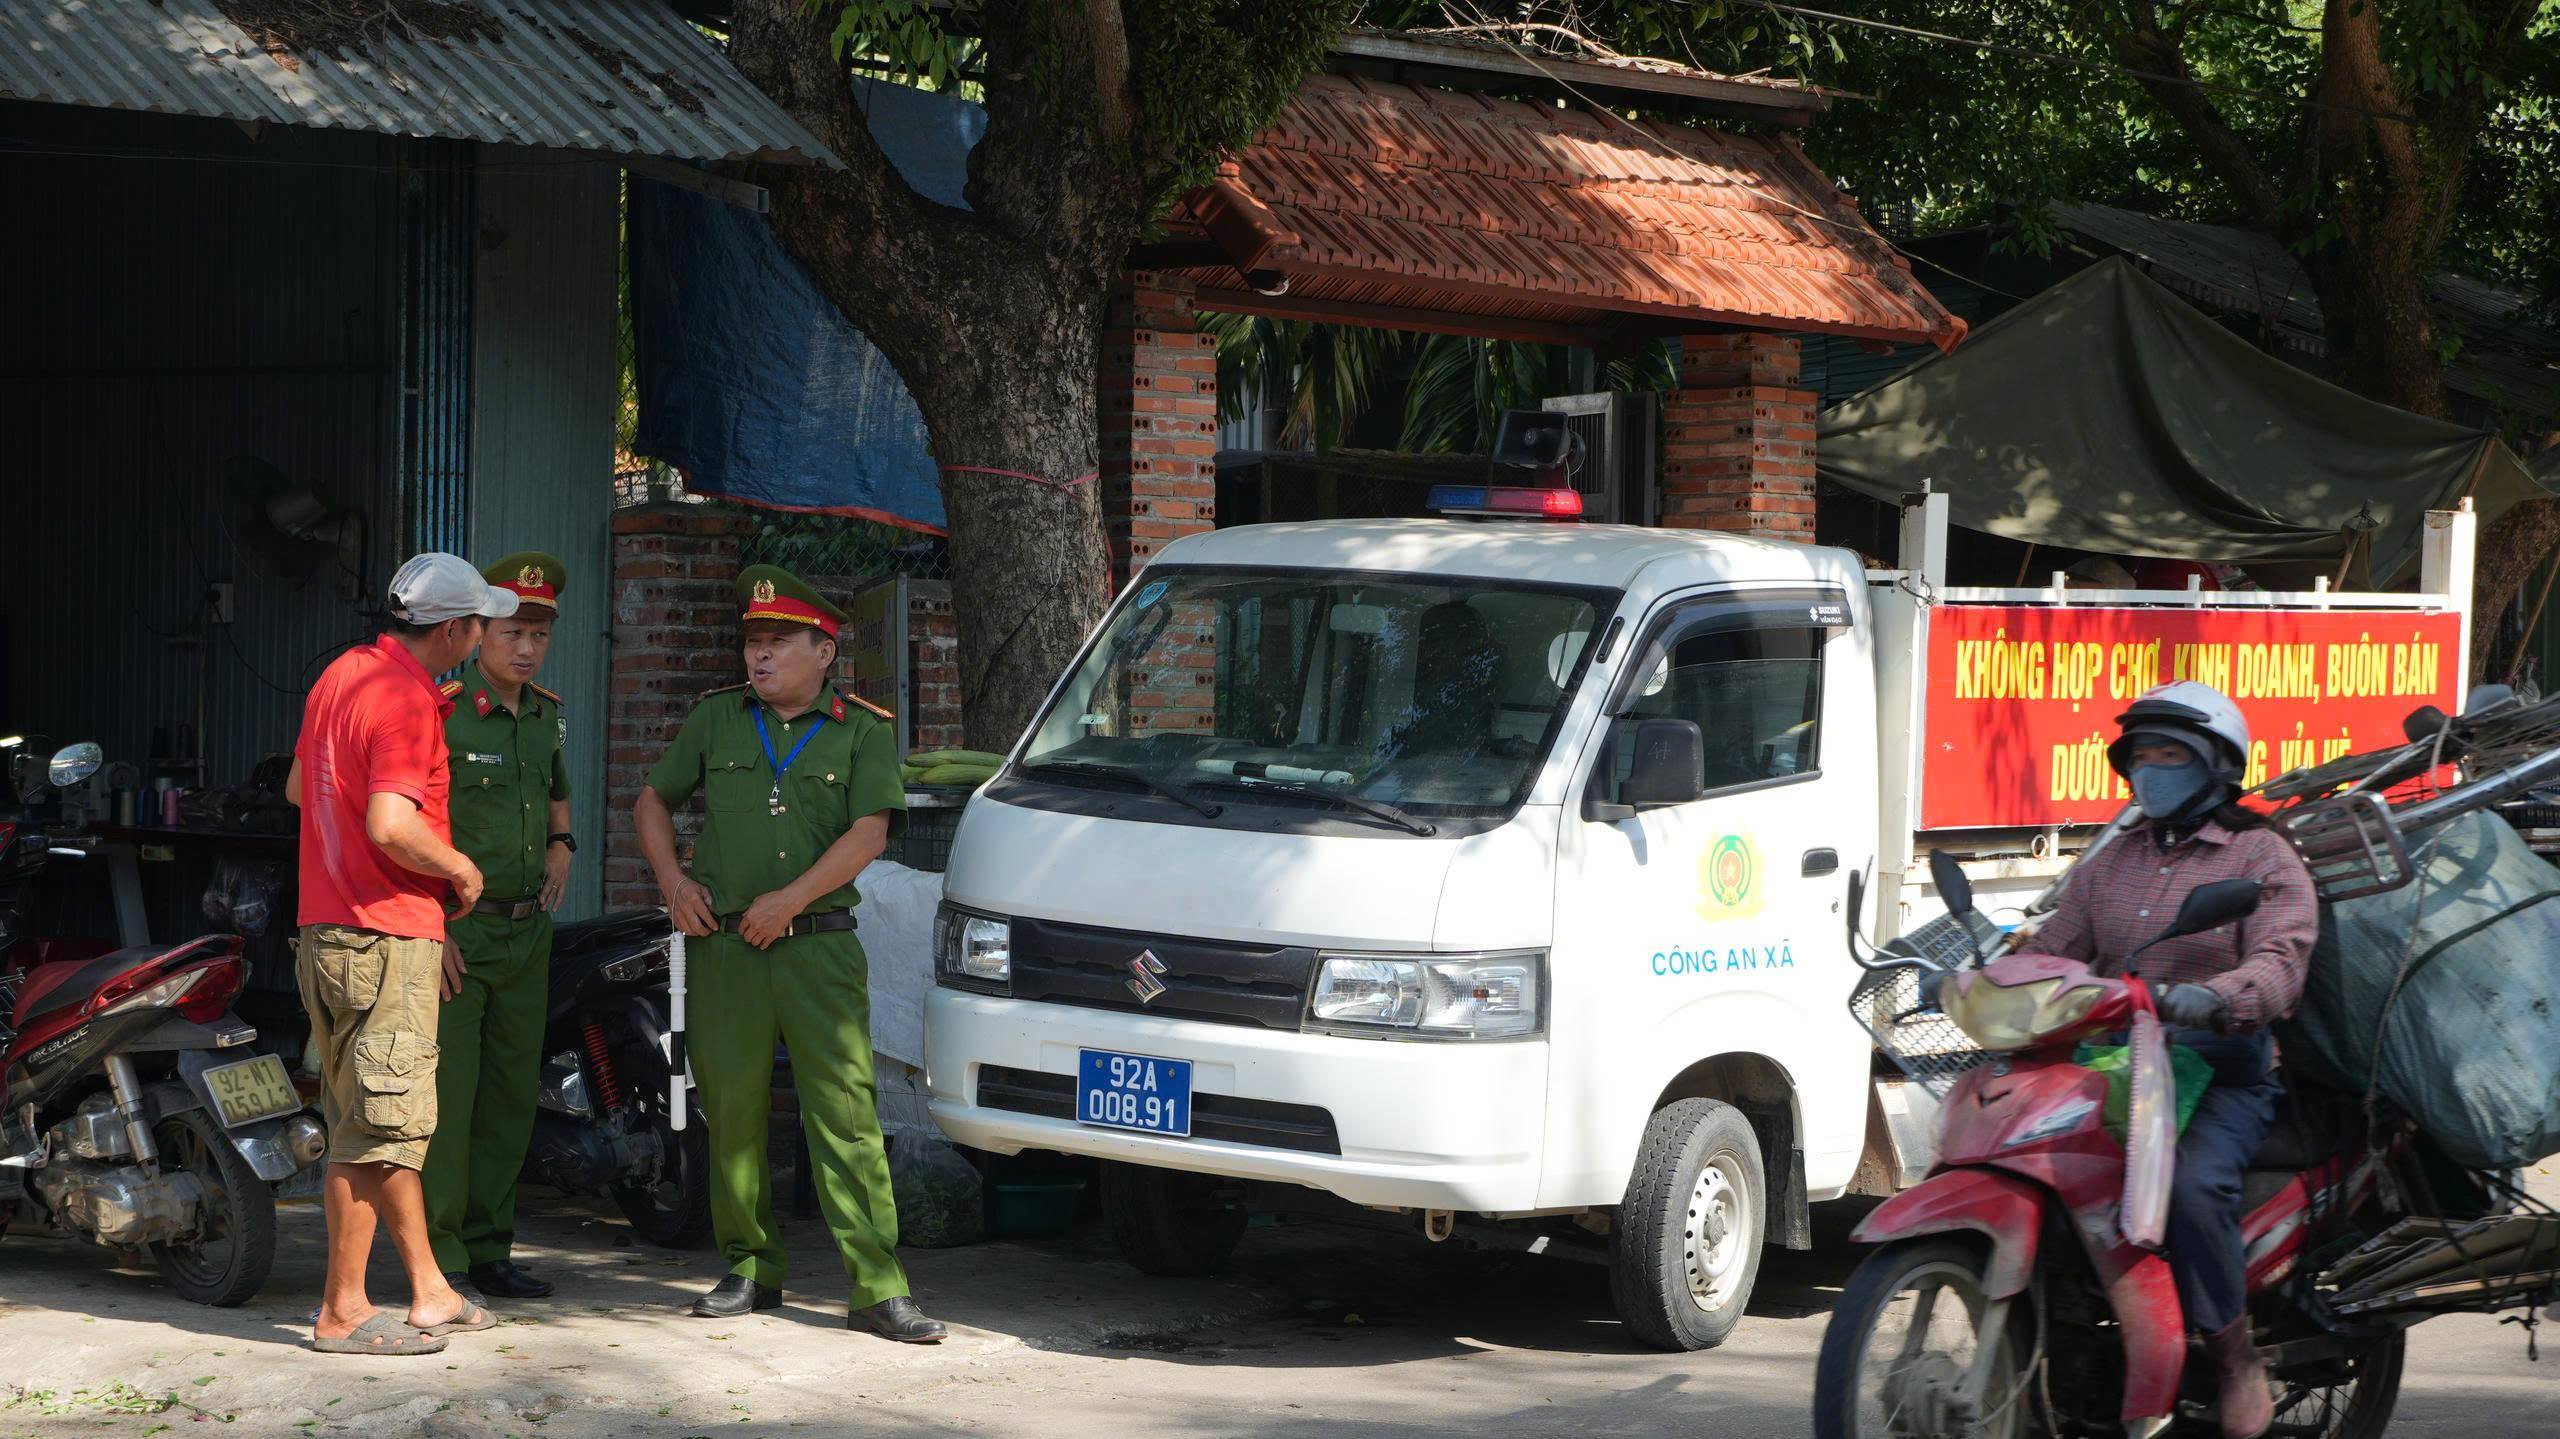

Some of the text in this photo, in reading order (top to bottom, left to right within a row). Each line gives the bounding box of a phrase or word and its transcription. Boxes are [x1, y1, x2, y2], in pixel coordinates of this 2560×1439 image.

[1955, 627, 2045, 700] KHÔNG
[2051, 641, 2103, 713] HỌP
[2173, 643, 2231, 698] KINH
[2236, 643, 2320, 704] DOANH,
[2326, 632, 2388, 698] BUÔN
[2392, 632, 2439, 696] BÁN
[2051, 731, 2110, 801] DƯỚI
[1652, 938, 1794, 976] CÔNG AN XÃ
[1110, 1056, 1158, 1092] 92A
[1089, 1088, 1175, 1130] 008.91
